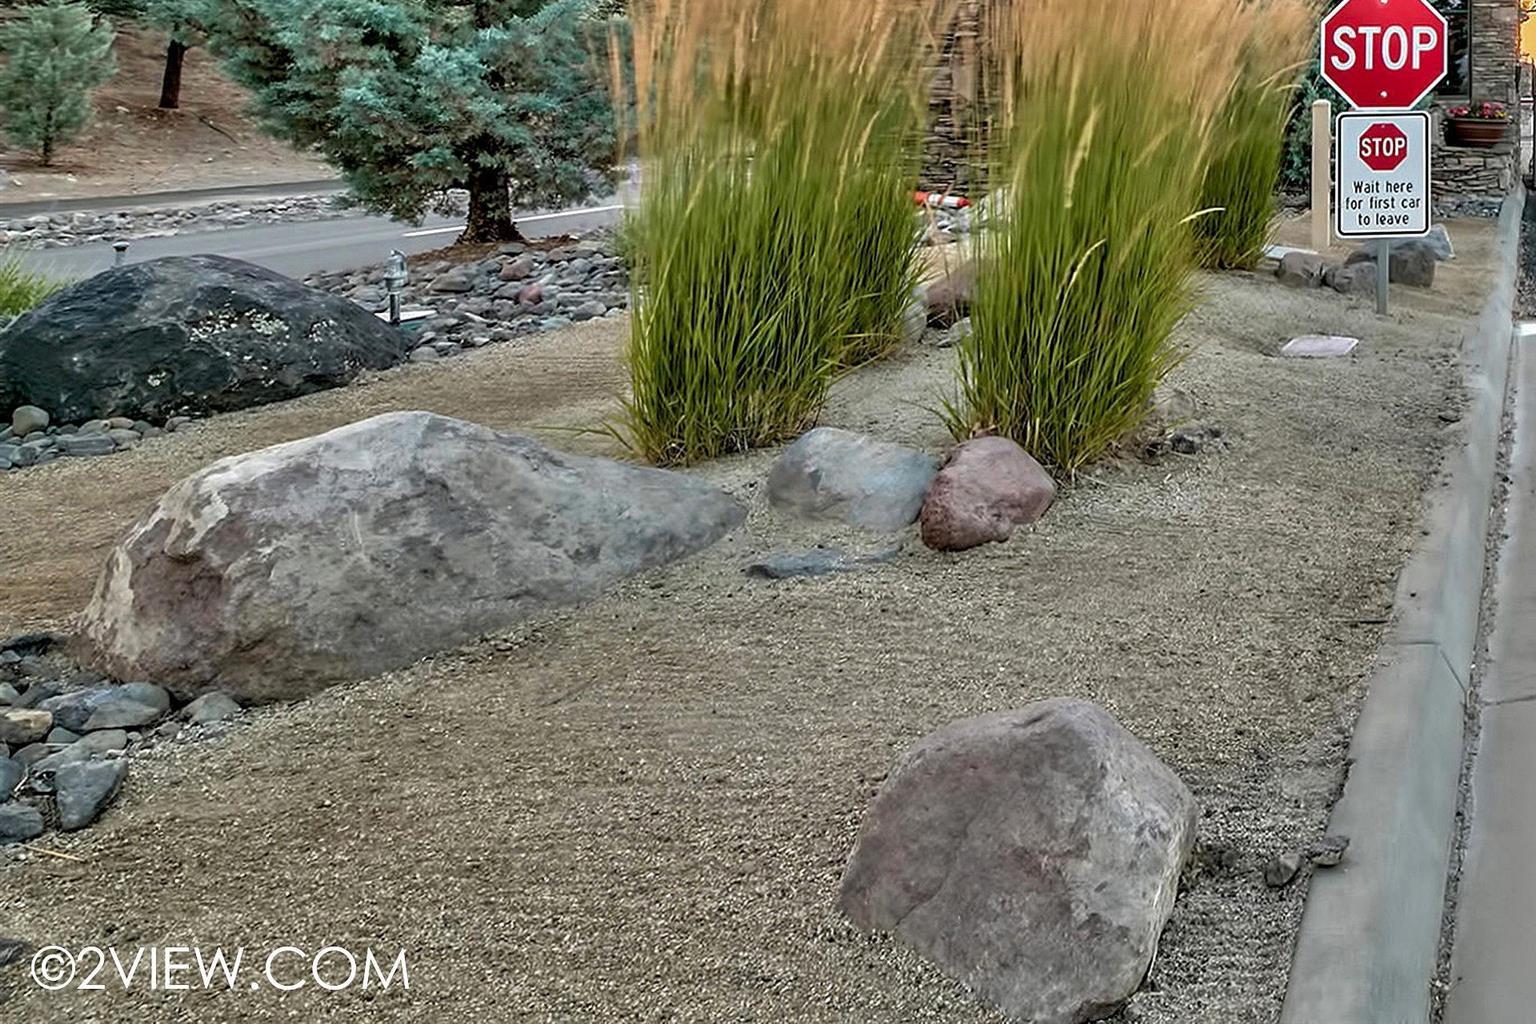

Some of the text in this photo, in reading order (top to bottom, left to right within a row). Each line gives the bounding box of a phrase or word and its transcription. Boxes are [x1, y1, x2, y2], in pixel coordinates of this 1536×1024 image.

[1330, 25, 1439, 71] STOP
[1360, 136, 1406, 157] STOP
[1353, 180, 1413, 194] Wait here
[1345, 196, 1420, 210] for first car
[1358, 212, 1410, 226] to leave
